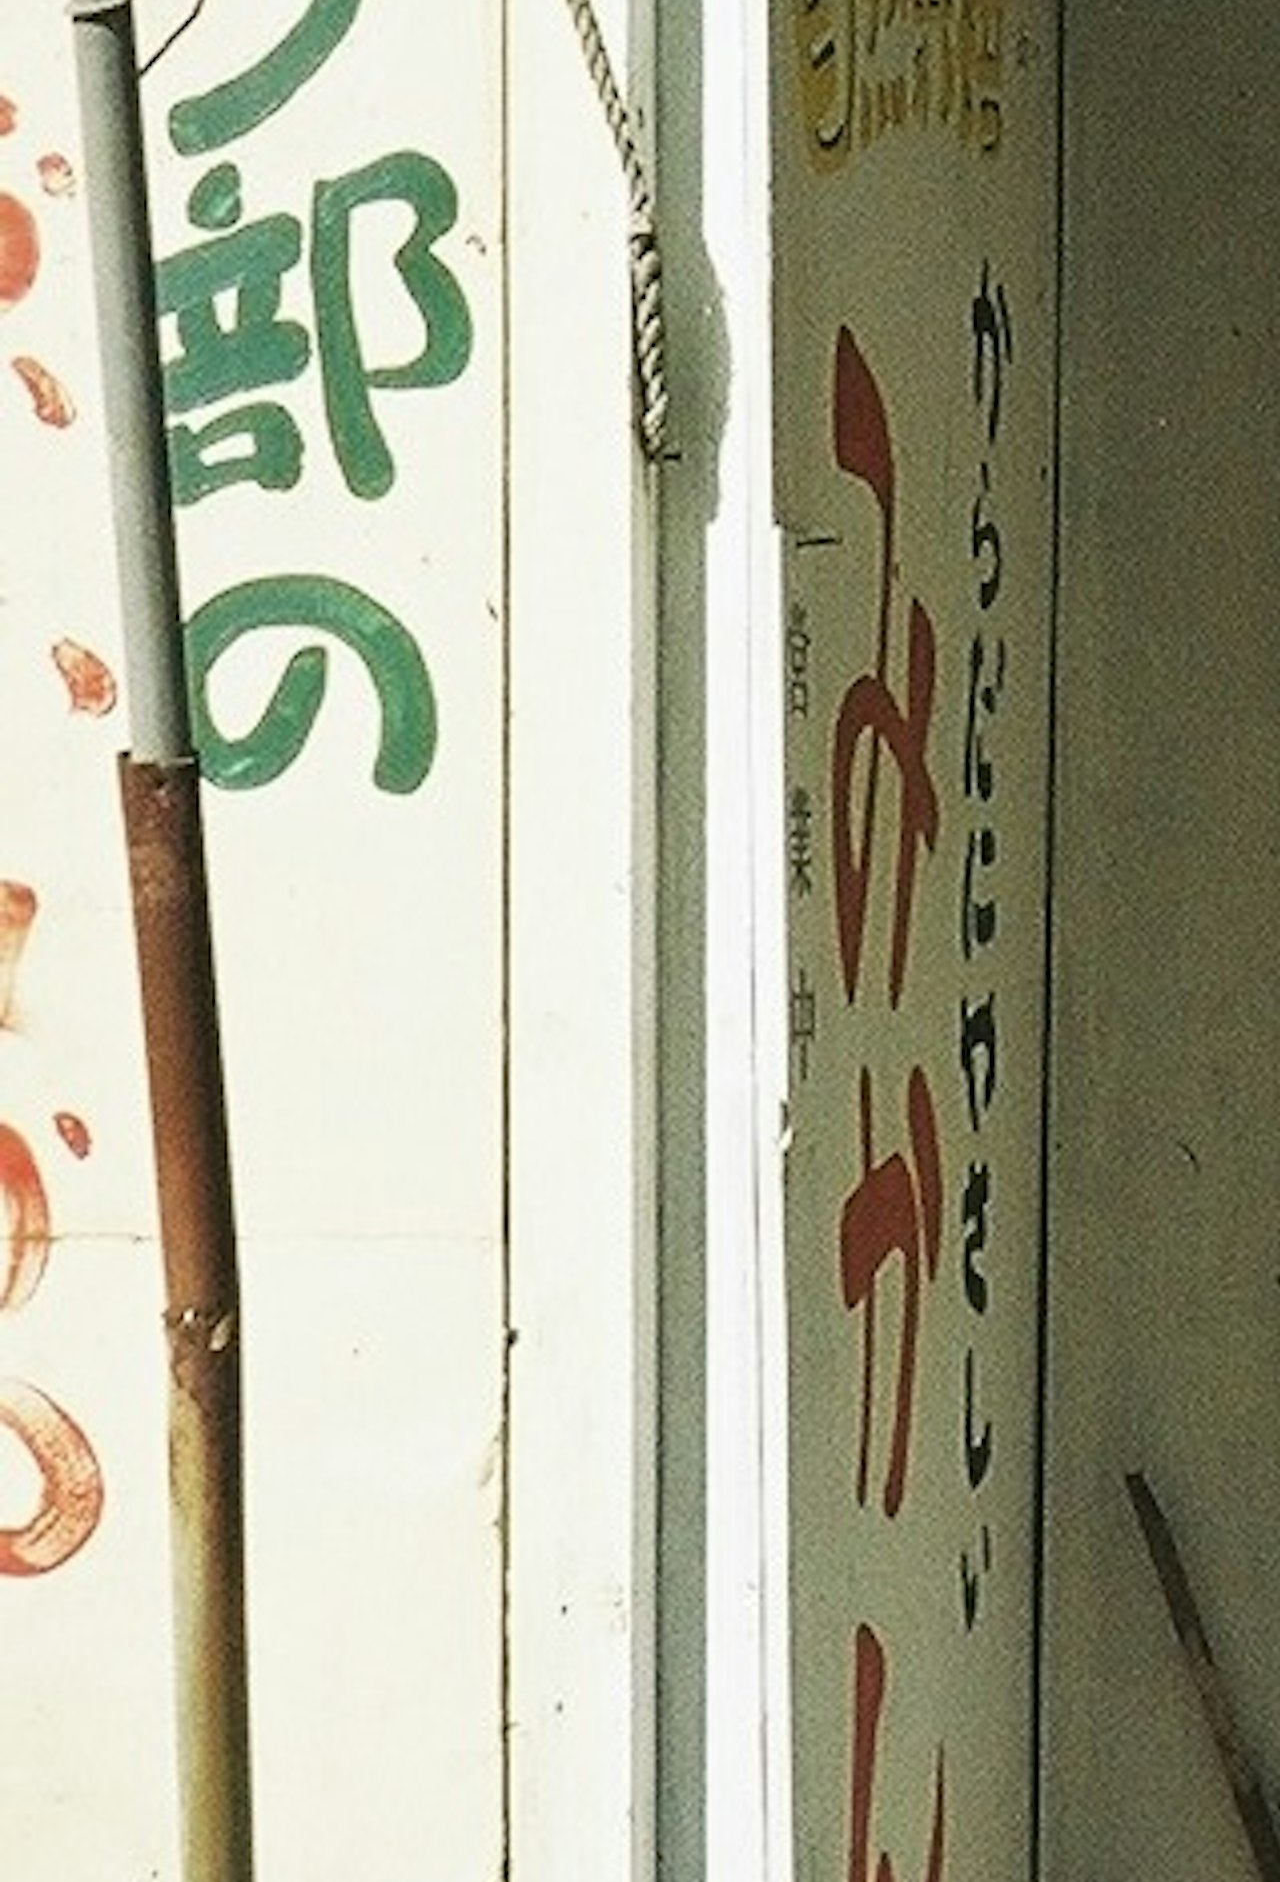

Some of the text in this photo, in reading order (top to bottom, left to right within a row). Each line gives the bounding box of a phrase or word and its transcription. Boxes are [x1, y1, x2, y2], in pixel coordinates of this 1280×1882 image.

[960, 256, 1013, 1636] からだにやさしい
